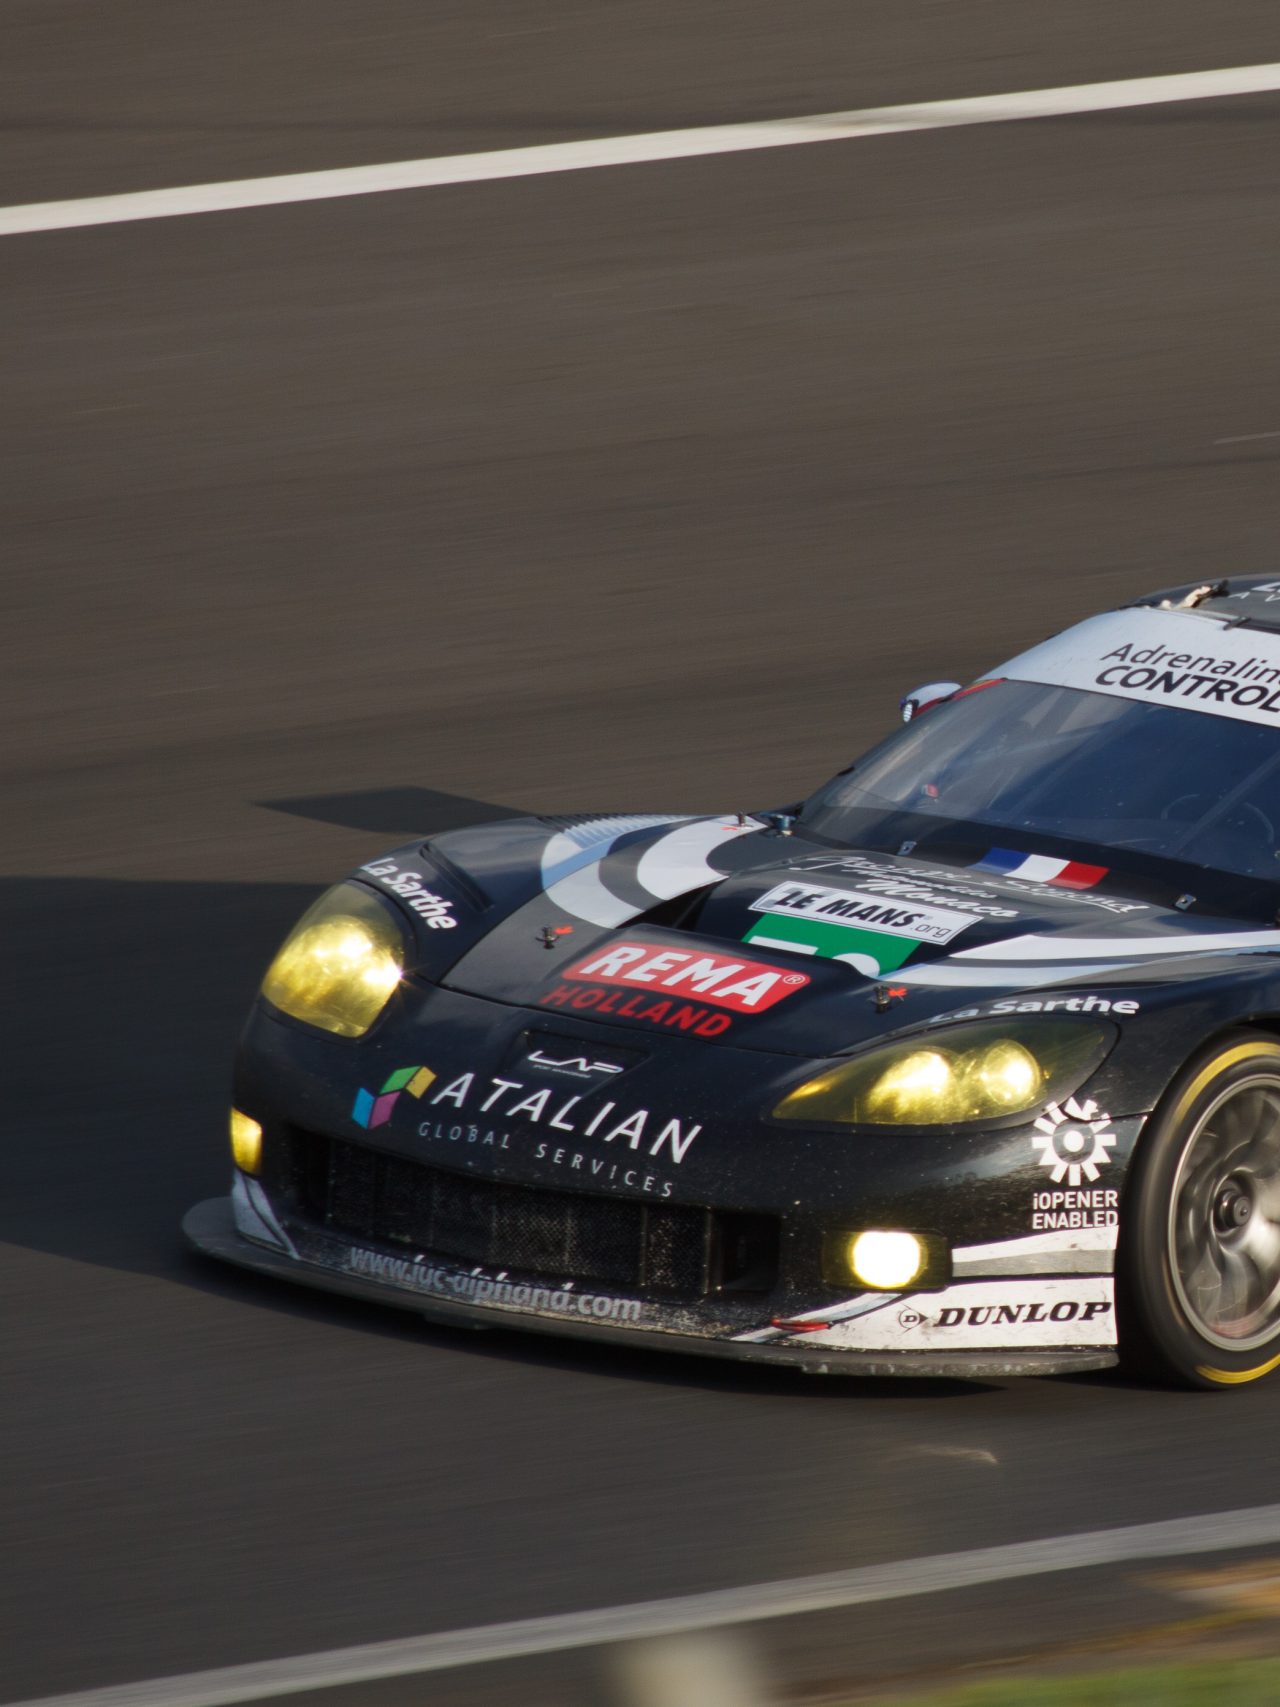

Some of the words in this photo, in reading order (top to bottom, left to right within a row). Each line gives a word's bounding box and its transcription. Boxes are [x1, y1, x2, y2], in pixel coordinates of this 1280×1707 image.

[360, 857, 399, 877] La
[380, 872, 458, 929] Sarthe
[774, 890, 825, 910] LE
[816, 898, 925, 928] MANS
[579, 946, 783, 1007] REMA
[547, 985, 733, 1037] HOLLAND
[929, 1008, 980, 1024] La
[988, 995, 1140, 1015] Sarthe
[430, 1072, 703, 1164] ATALIAN
[418, 1121, 511, 1150] GLOBAL
[534, 1142, 673, 1198] SERVICES
[1032, 1190, 1118, 1210] iOPENER
[1032, 1210, 1119, 1230] ENABLED
[350, 1247, 641, 1321] www.luc-alphand.com
[933, 1301, 1112, 1328] DUNLOP
